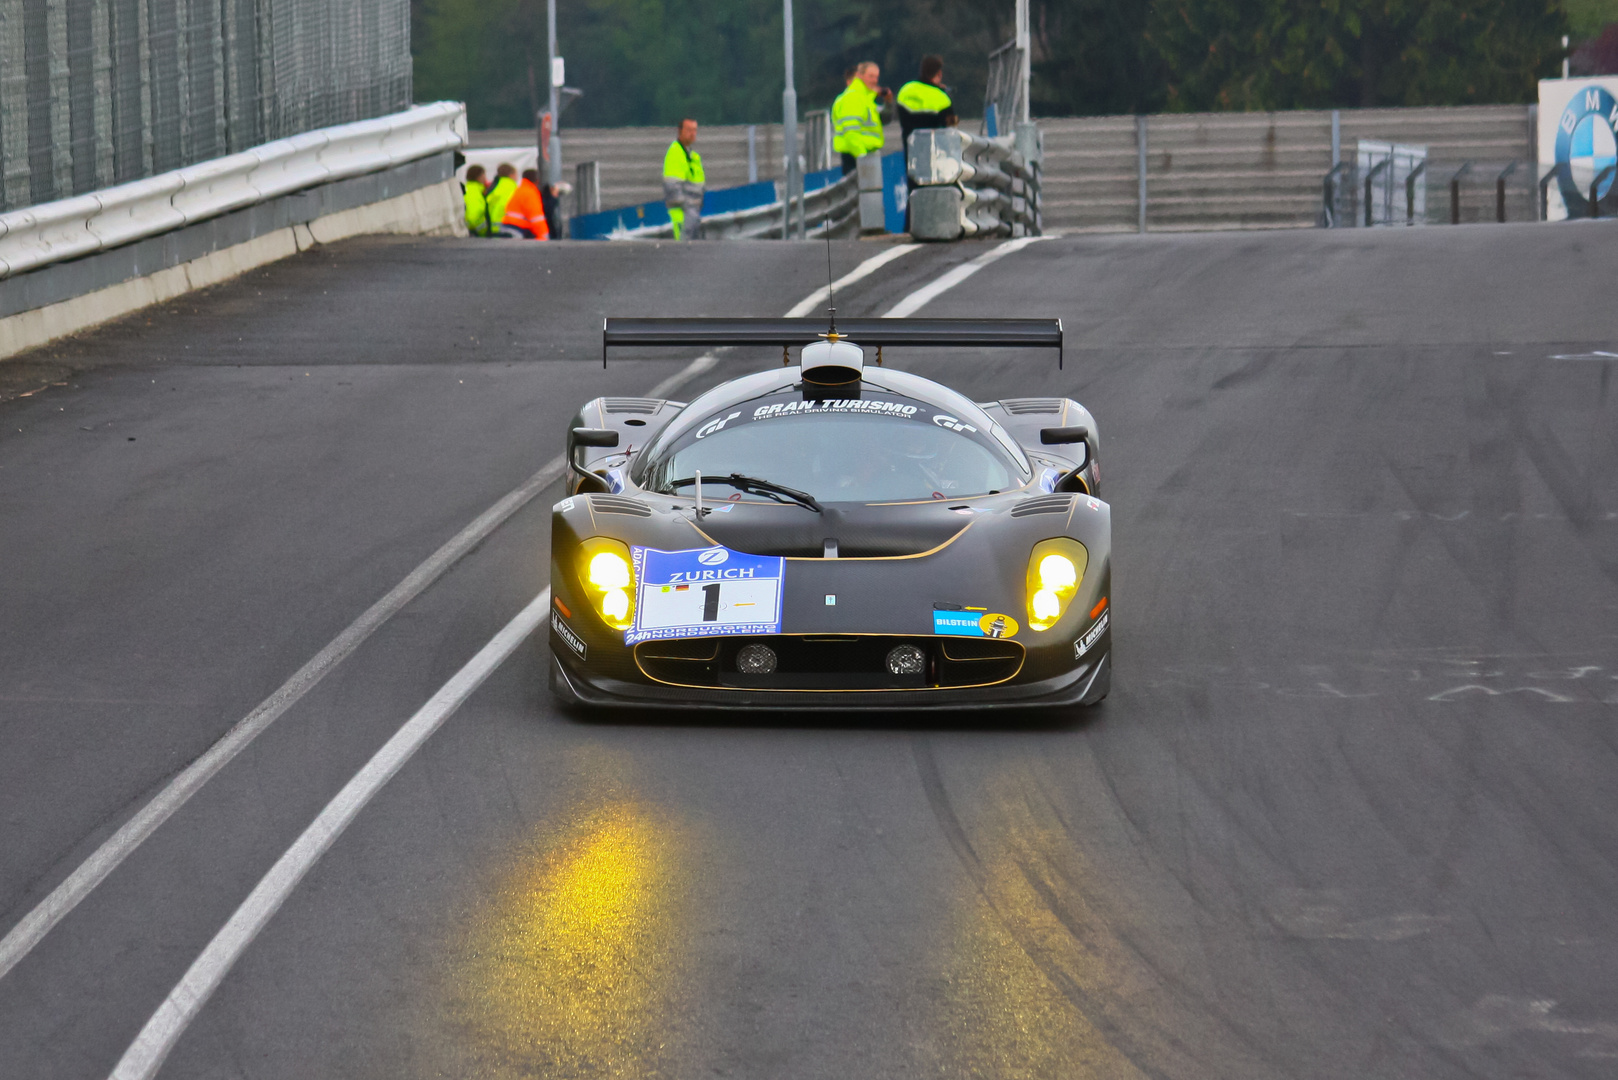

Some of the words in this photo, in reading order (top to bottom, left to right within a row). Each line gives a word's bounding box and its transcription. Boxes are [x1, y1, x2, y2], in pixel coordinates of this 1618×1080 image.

[754, 400, 816, 416] GRAN
[822, 399, 917, 414] TURISMO
[850, 408, 911, 418] SIMULATOR
[669, 568, 754, 583] ZURICH
[702, 583, 720, 621] 1
[936, 618, 978, 627] BILSTEIN
[559, 621, 584, 653] MICHELIN
[625, 630, 651, 645] 24h
[652, 629, 776, 638] NORDSCHLEIFE
